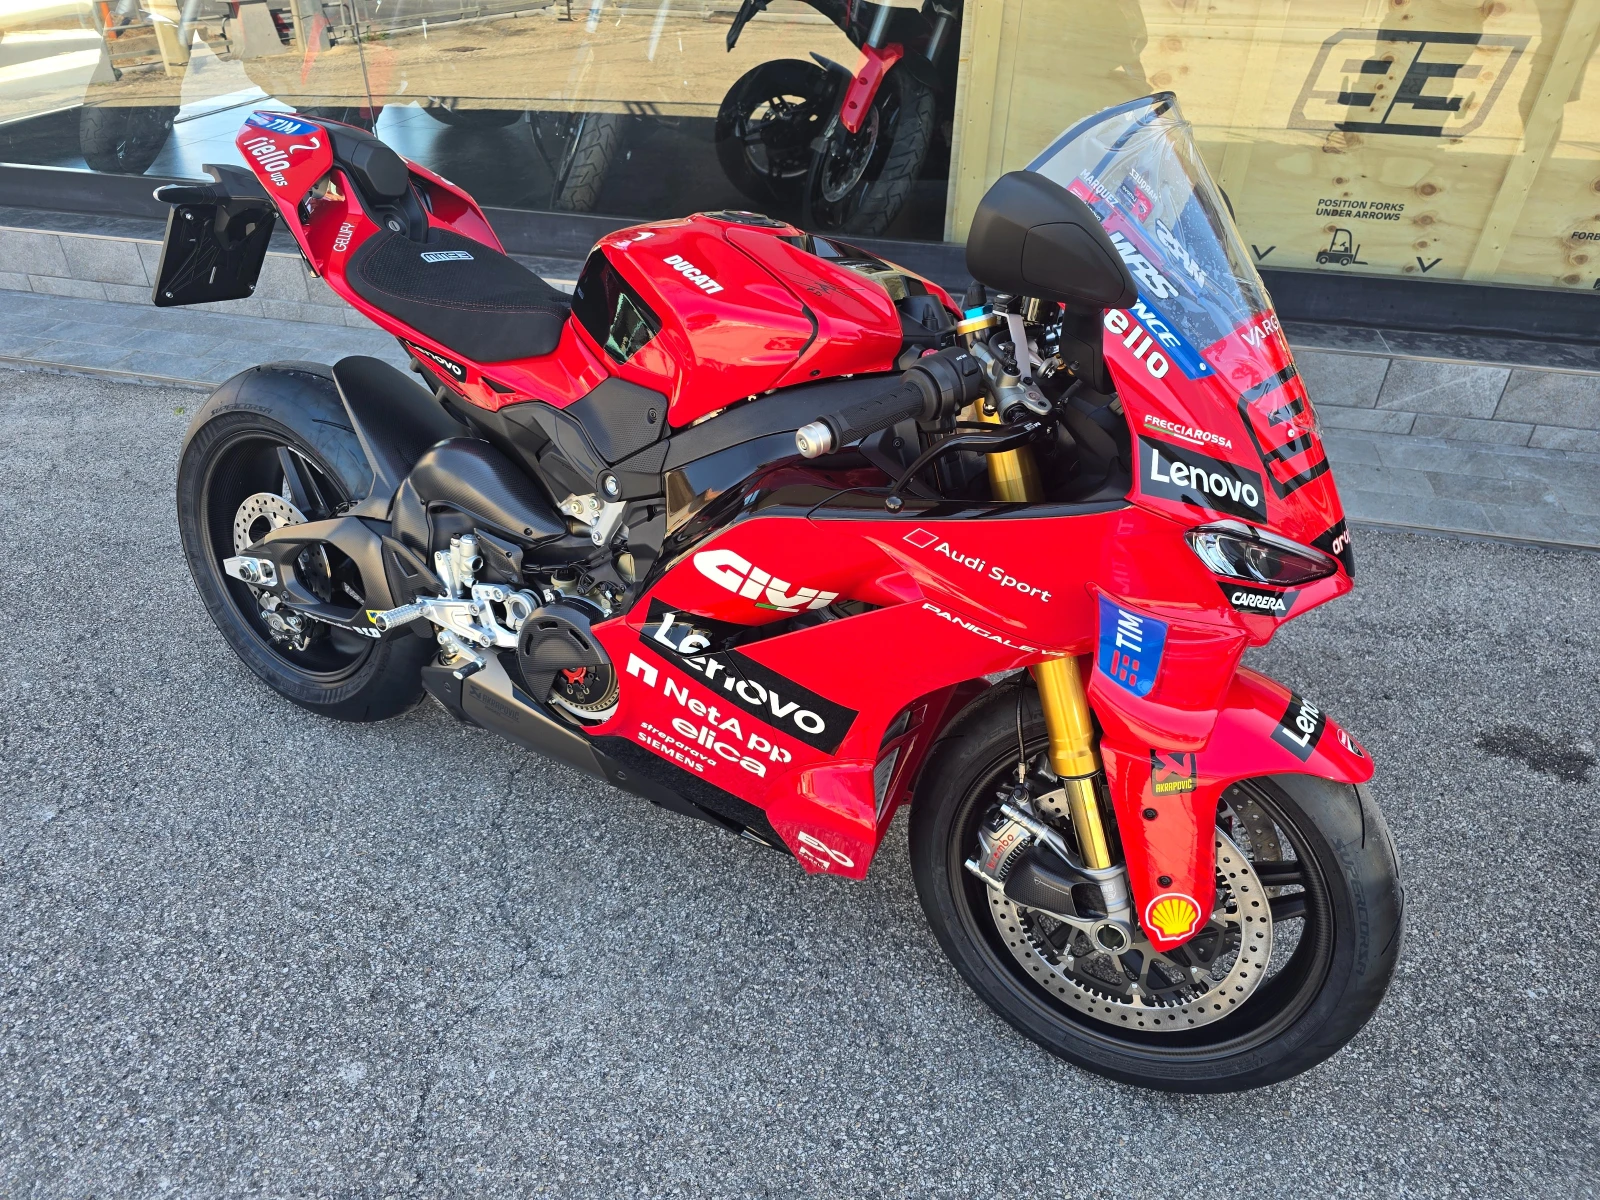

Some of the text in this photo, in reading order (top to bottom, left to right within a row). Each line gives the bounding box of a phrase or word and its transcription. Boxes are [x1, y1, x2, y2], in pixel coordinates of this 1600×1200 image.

[265, 118, 302, 134] TIM
[243, 136, 290, 187] riello ups
[1080, 168, 1119, 208] MARQUEZ
[1317, 198, 1405, 212] POSITION FORKS
[1315, 208, 1401, 221] UNDER ARROWS
[662, 254, 724, 295] DUCATI
[1103, 308, 1170, 379] ello
[1130, 300, 1182, 349] NCE
[1144, 414, 1233, 450] FRECCIAROSSA
[1150, 447, 1259, 508] Lenovo
[693, 549, 840, 610] GIVI
[934, 542, 1052, 603] Audi Sport
[1231, 591, 1287, 611] CARRERA
[921, 602, 1038, 654] PANIGALE
[1115, 608, 1144, 653] TIM
[653, 612, 826, 734] Lenovo
[663, 677, 792, 764] NetApp
[637, 731, 704, 773] SIEMENS
[640, 721, 717, 767] streparava
[671, 717, 768, 778] elica
[986, 833, 1014, 870] brembo
